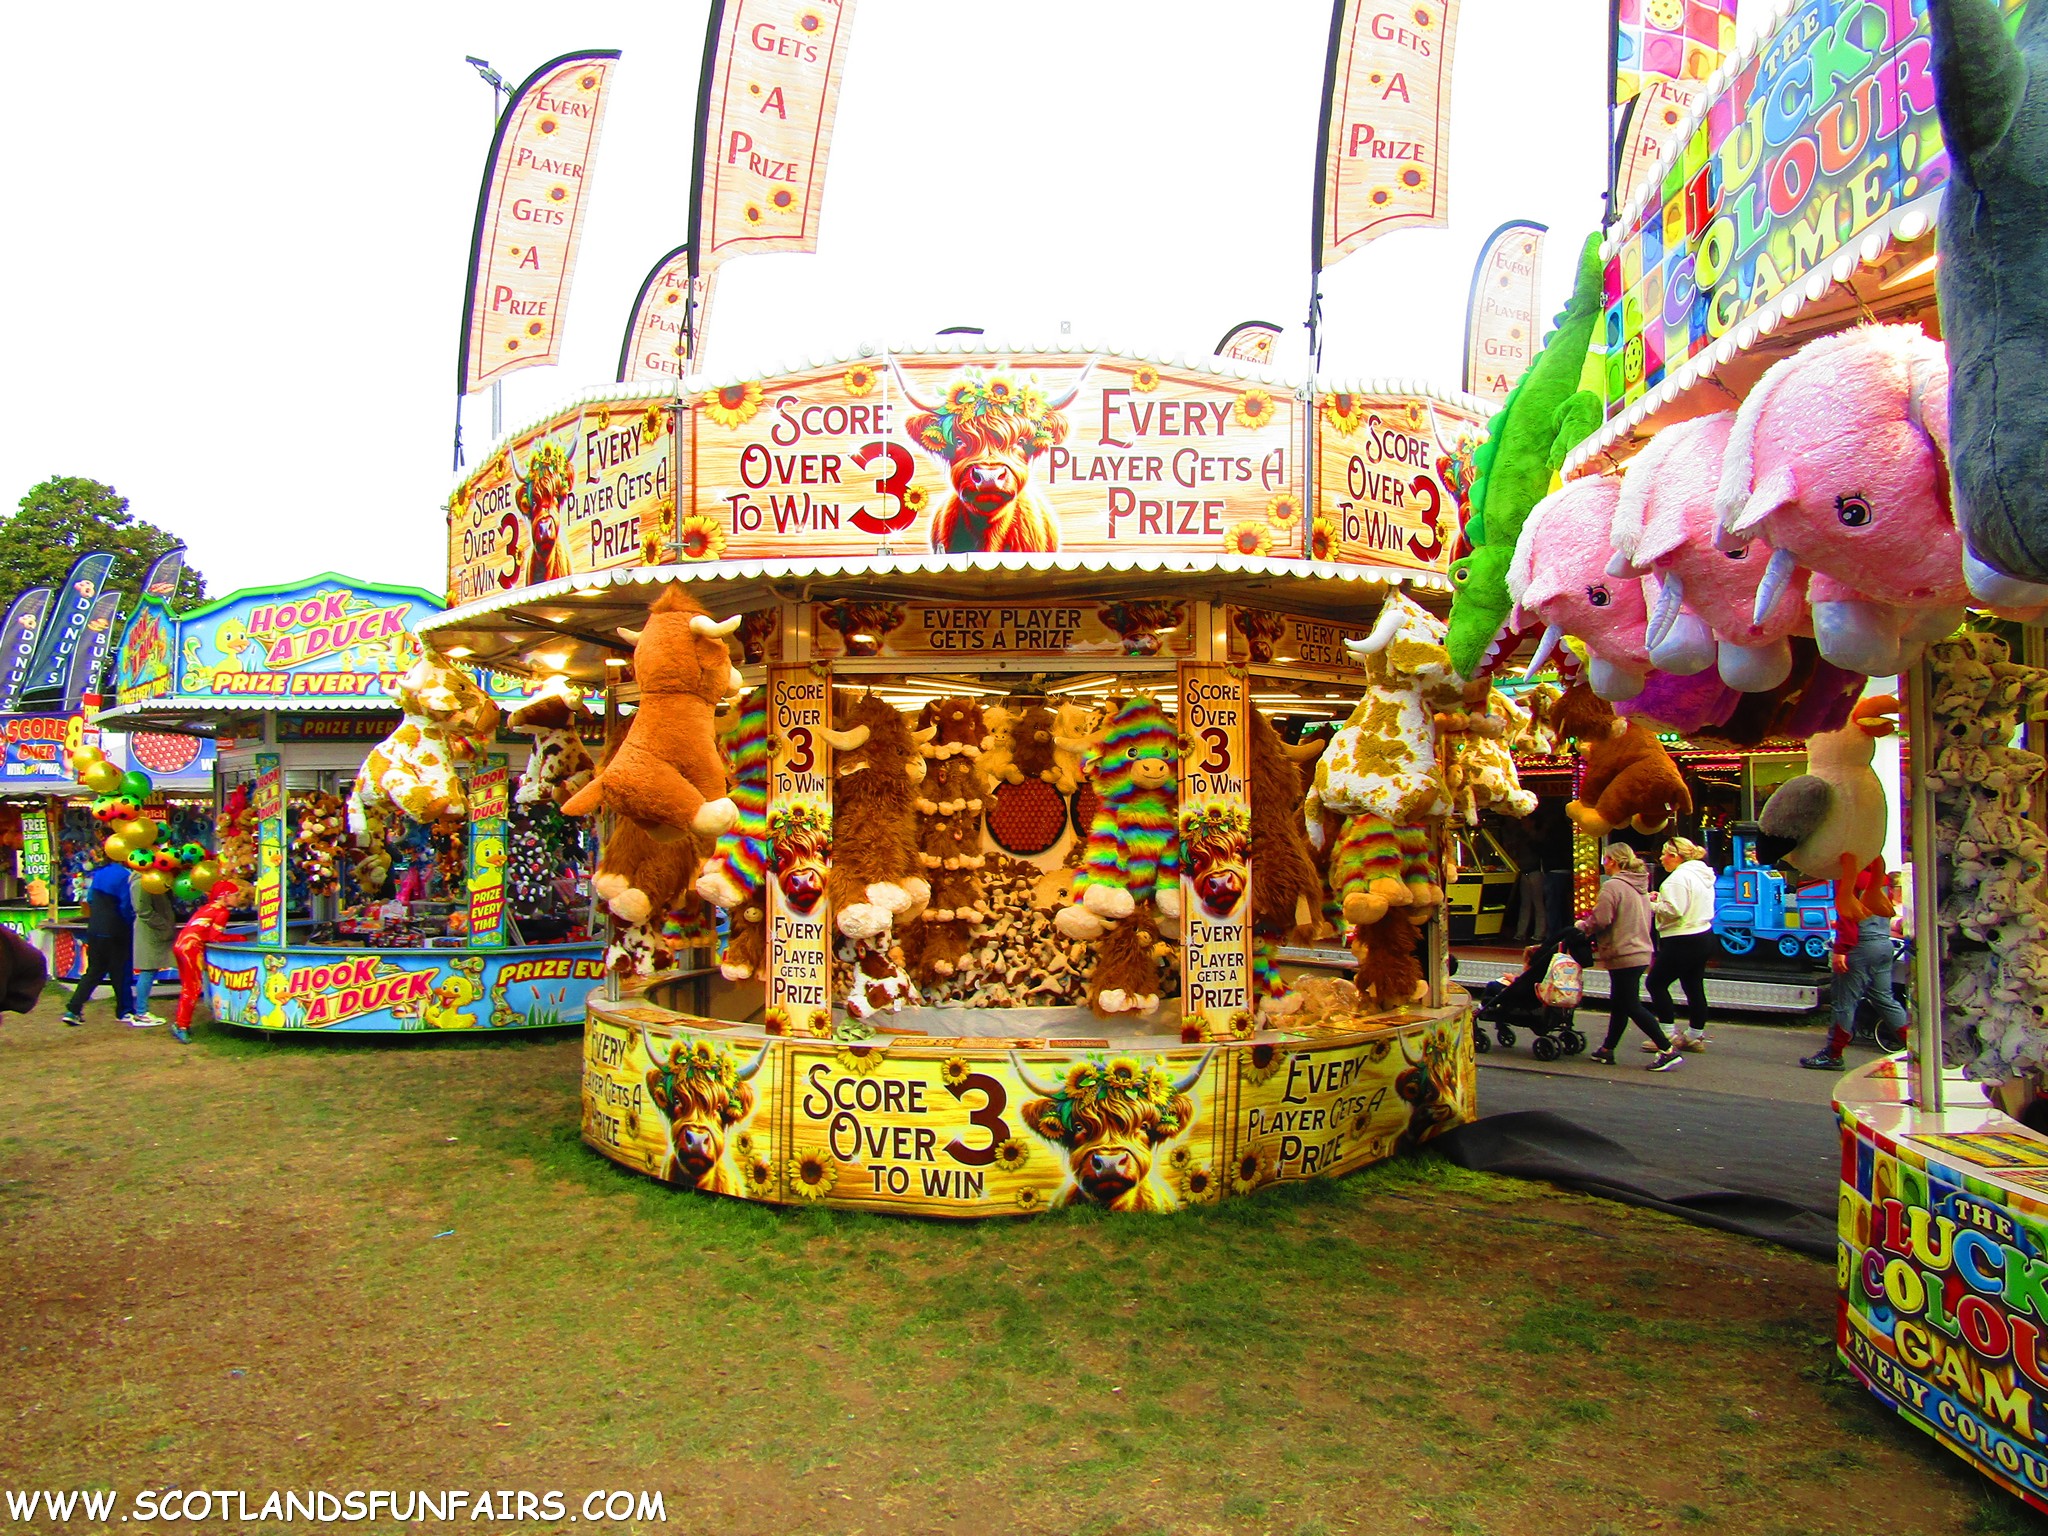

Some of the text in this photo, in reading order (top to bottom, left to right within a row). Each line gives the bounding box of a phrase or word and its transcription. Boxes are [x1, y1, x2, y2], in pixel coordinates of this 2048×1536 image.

[751, 22, 818, 63] GETS
[1371, 13, 1430, 57] GETS
[1765, 8, 1820, 77] THE
[1381, 72, 1410, 103] A
[1661, 82, 1695, 107] EVE
[535, 91, 592, 119] EVERY
[759, 87, 787, 120] A
[727, 130, 798, 183] PRIZE
[1348, 122, 1425, 163] PRIZE
[516, 147, 583, 178] PLAYER
[1663, 37, 1935, 327] COLOUR
[512, 198, 564, 226] GETS
[1706, 133, 1918, 339] GAME!
[519, 246, 540, 270] A
[1496, 252, 1531, 277] EVERY
[492, 285, 547, 316] PRIZE
[1486, 297, 1530, 322] PLAYER
[1484, 338, 1522, 358] GETS
[1492, 374, 1509, 392] A
[770, 396, 893, 448] SCORE
[1099, 388, 1234, 449] EVERY
[586, 422, 642, 484] EVERY
[1365, 414, 1430, 470] SCORE
[1049, 445, 1286, 492] PLAYER GETS A
[567, 457, 668, 526] PLAYER GETS A
[739, 440, 916, 535] OVER 3
[472, 482, 511, 528] SCORE
[727, 493, 840, 534] TO WIN
[1107, 486, 1225, 539] PRIZE
[1347, 455, 1443, 563] OVER 3
[590, 516, 641, 566] PRIZE
[1337, 502, 1403, 551] TO WIN
[463, 512, 521, 590] OVER 3
[457, 562, 494, 601] TO WIN
[250, 592, 351, 635] HOOK
[923, 609, 1082, 631] EVERY PLAYER
[48, 598, 91, 683] DONUTS
[266, 605, 406, 665] A DUCK
[930, 628, 1073, 649] GETS A PRIZE
[1296, 623, 1334, 645] EVERY
[1300, 643, 1331, 663] GETS
[1335, 648, 1344, 665] A
[3, 630, 35, 710] DONUTS
[80, 633, 106, 708] BURGE
[215, 674, 288, 693] PRIZE
[292, 674, 376, 693] EVERY
[774, 680, 824, 706] SCORE
[1186, 678, 1241, 704] SCORE
[304, 720, 350, 734] PRIZE
[778, 705, 820, 728] OVER
[1190, 704, 1237, 728] OVER
[6, 718, 66, 744] SCORE
[64, 714, 84, 752] 8
[17, 743, 56, 761] OVER
[785, 727, 815, 773] 3
[1199, 727, 1231, 774] 3
[258, 768, 279, 788] HOOK
[266, 788, 273, 799] A
[472, 768, 505, 788] HOOK
[774, 773, 824, 794] TO WIN
[1187, 774, 1242, 795] TO WIN
[484, 789, 493, 799] A
[22, 818, 46, 832] FREE
[258, 801, 279, 821] DUCK
[472, 801, 504, 821] DUCK
[27, 865, 49, 874] LOSE
[28, 853, 47, 863] YOU
[260, 887, 279, 903] PRIZE
[473, 887, 501, 905] PRIZE
[1743, 881, 1752, 898] 1
[260, 902, 279, 918] EVERY
[261, 915, 277, 930] TIME
[471, 902, 502, 920] EVERY
[474, 917, 497, 931] TIME
[774, 917, 823, 946] EVERY
[1190, 921, 1243, 948] EVERY
[773, 945, 823, 966] PLAYER
[1190, 949, 1244, 971] PLAYER
[223, 968, 256, 988] TIME!
[289, 957, 379, 993] HOOK
[500, 960, 571, 984] PRIZE
[780, 967, 817, 979] GETS A
[1197, 970, 1237, 982] GETS A
[308, 971, 437, 1022] A DUCK
[773, 978, 824, 1005] PRIZE
[1190, 982, 1244, 1012] PRIZE
[591, 1018, 626, 1067] EVERY
[605, 1073, 630, 1107] GETS
[633, 1084, 642, 1115] A
[803, 1063, 928, 1120] SCORE
[1282, 1054, 1369, 1105] EVERY
[591, 1096, 620, 1147] PRIZE
[829, 1073, 1011, 1166] OVER 3
[1247, 1086, 1388, 1143] PLAYER GETS A
[1276, 1133, 1345, 1180] PRIZE
[868, 1165, 985, 1199] TO WIN
[1955, 1199, 2013, 1241] THE
[1853, 1337, 1929, 1408] EVERY
[1894, 1319, 2048, 1446] GAM
